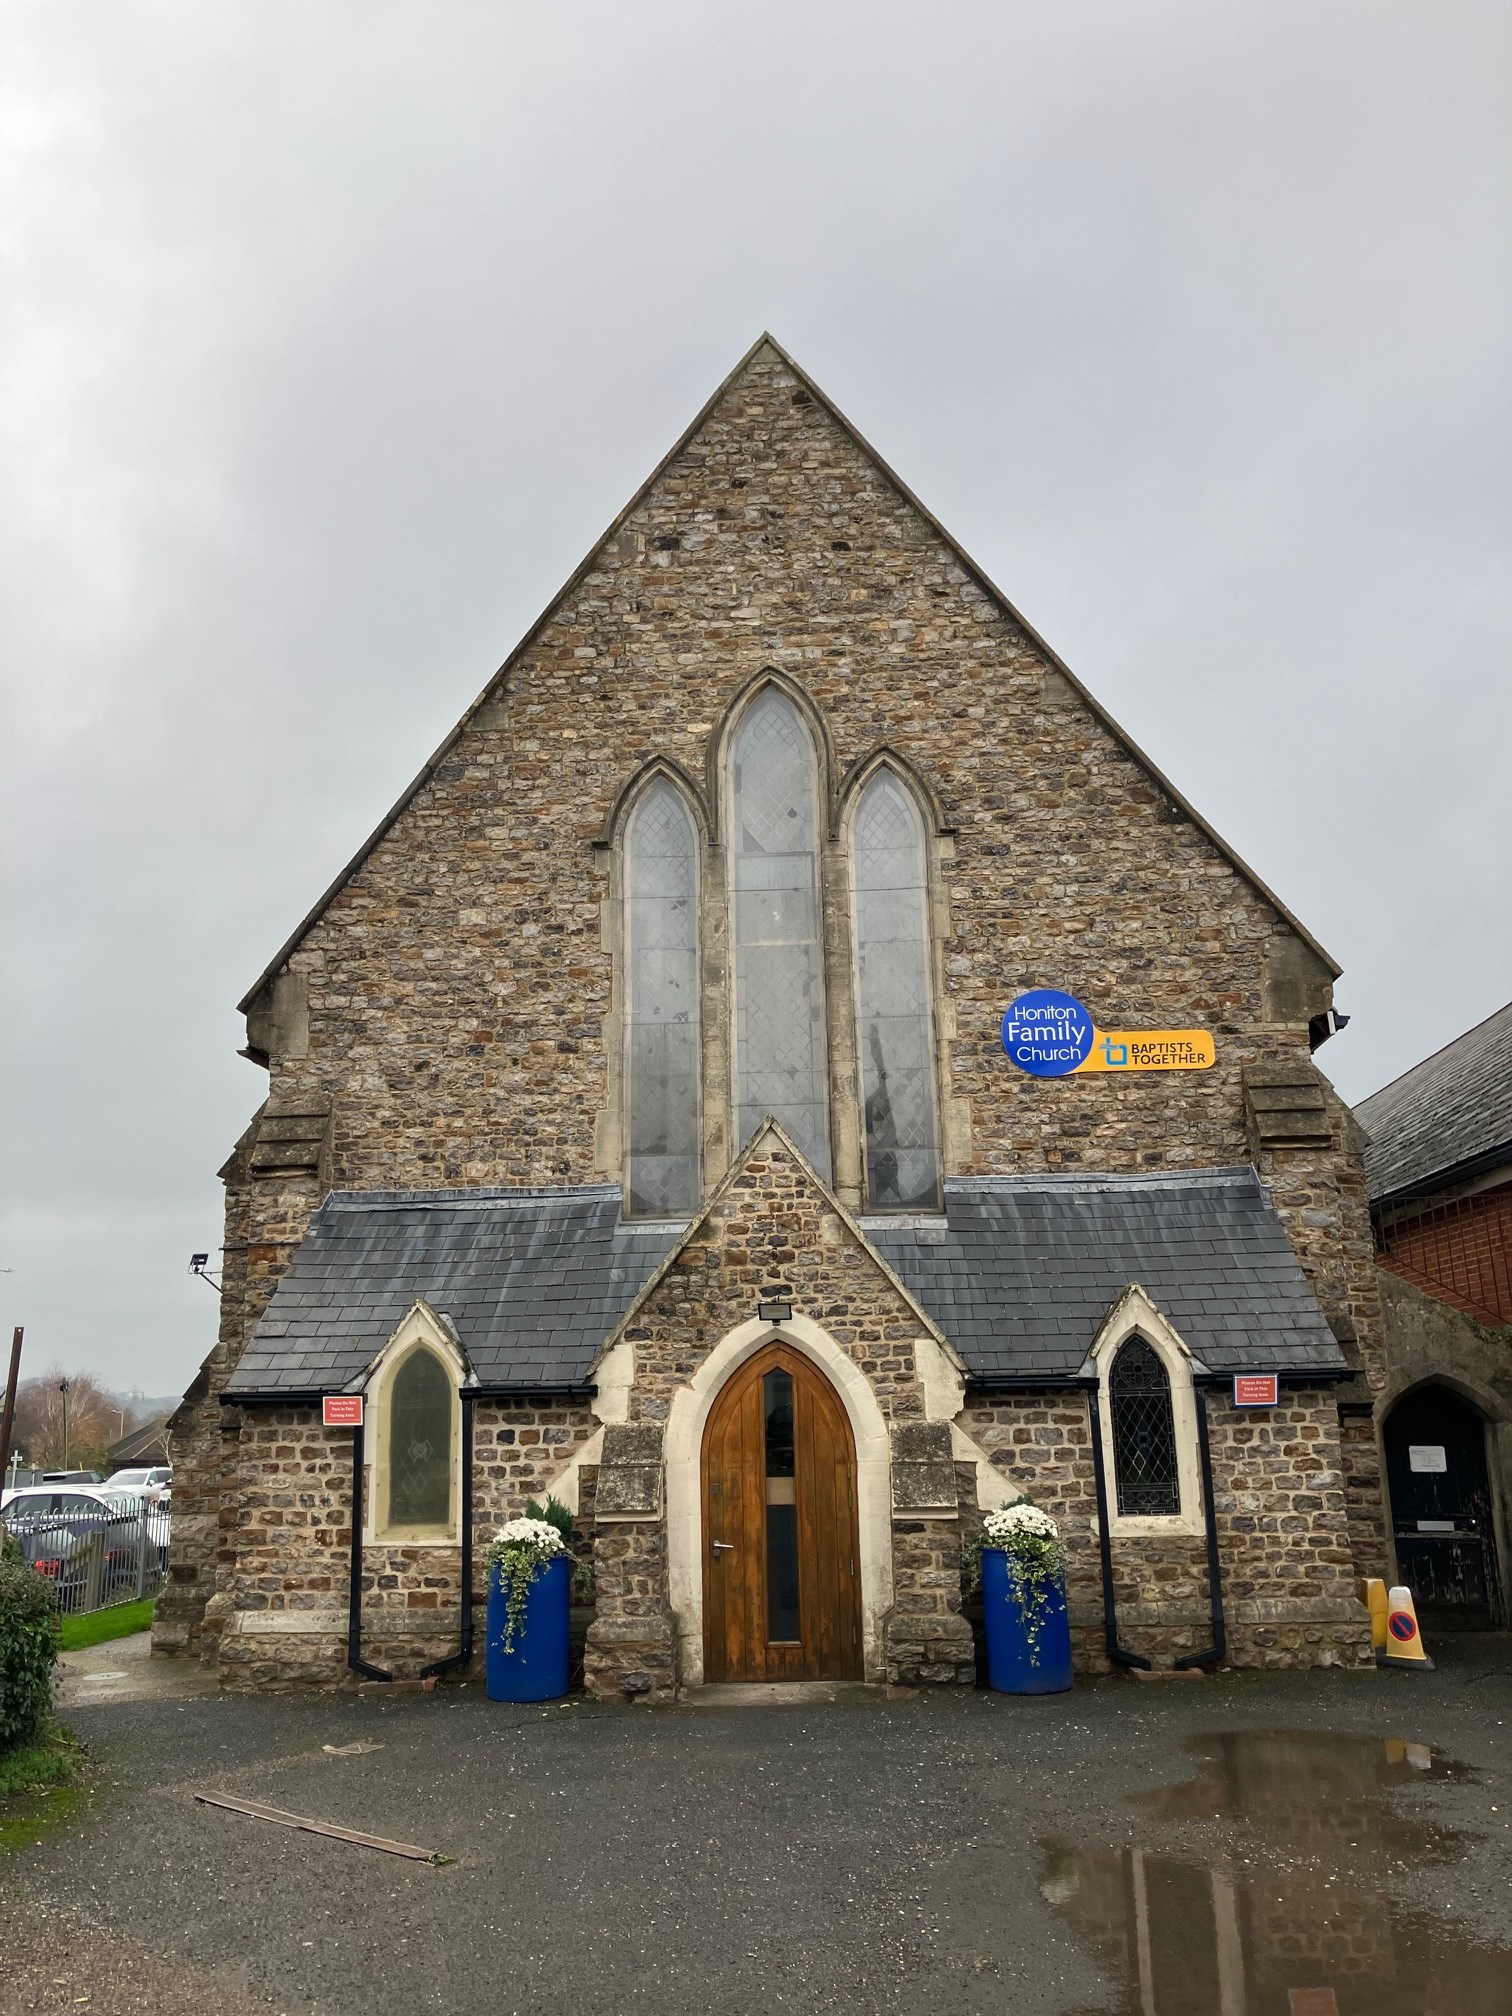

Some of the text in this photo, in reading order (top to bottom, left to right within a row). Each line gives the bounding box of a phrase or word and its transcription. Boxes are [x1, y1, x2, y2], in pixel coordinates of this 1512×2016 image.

[1014, 1006, 1076, 1020] Honiton
[1008, 1021, 1086, 1045] Family
[1016, 1046, 1081, 1062] Church
[1131, 1042, 1193, 1054] BAPTISTS
[1131, 1053, 1206, 1065] TOGETHER
